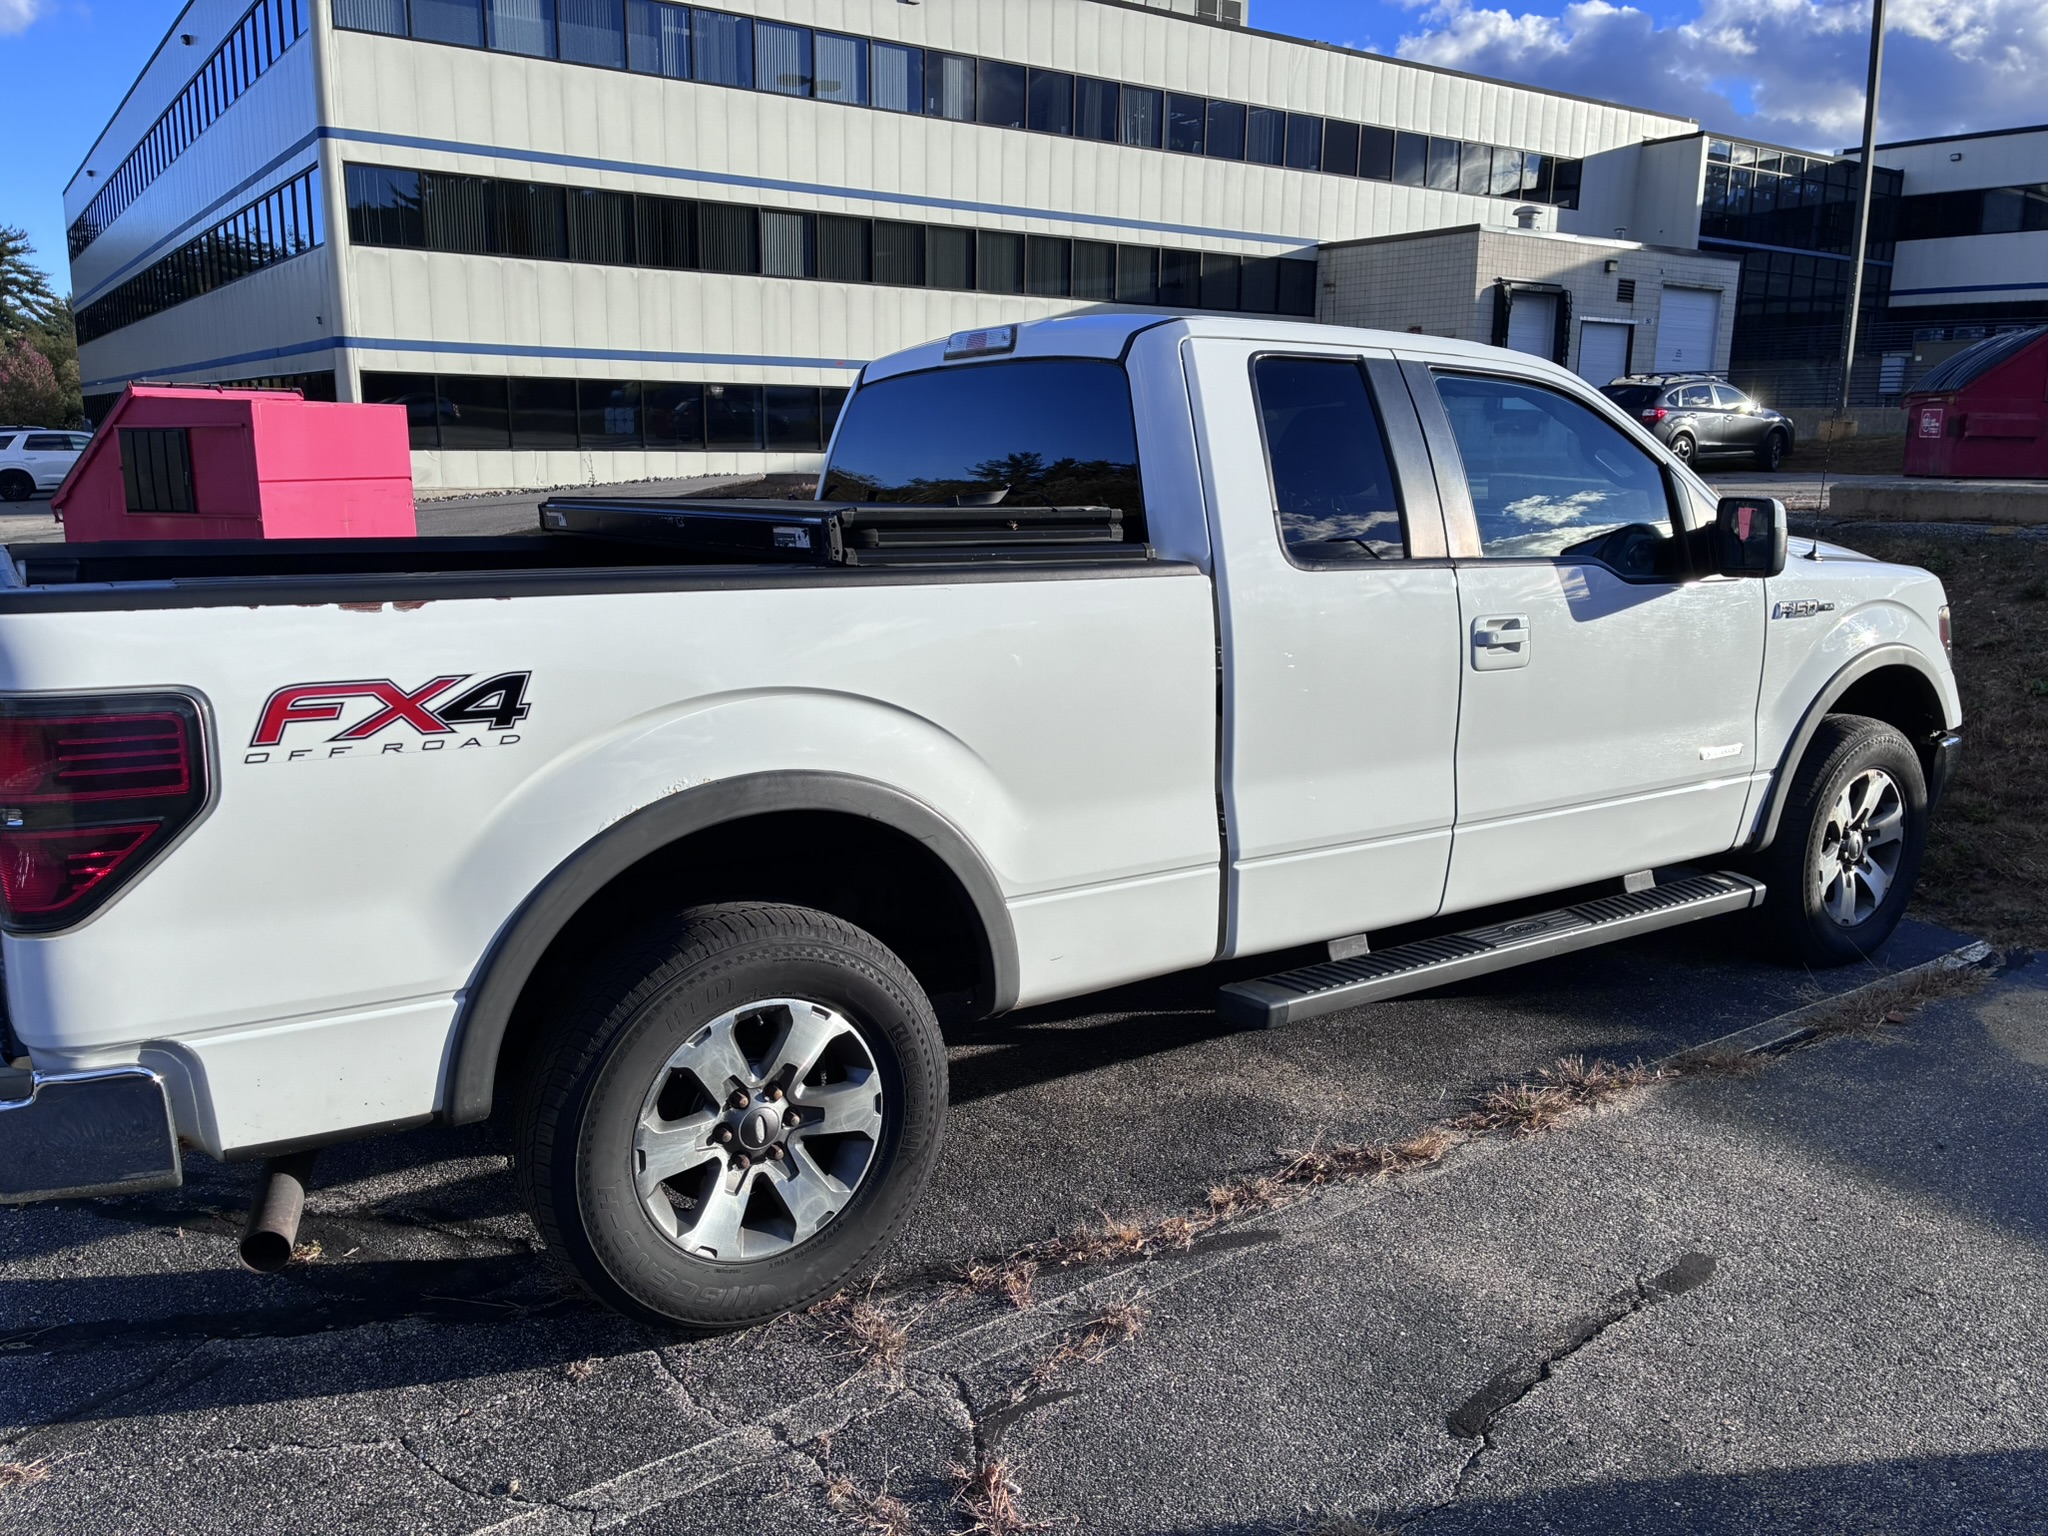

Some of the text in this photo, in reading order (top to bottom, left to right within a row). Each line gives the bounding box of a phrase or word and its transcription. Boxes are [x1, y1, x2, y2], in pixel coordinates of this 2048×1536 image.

[244, 734, 522, 765] OFF ROAD
[248, 670, 533, 748] FX4
[887, 1020, 925, 1166] BLACKHAWK
[597, 1186, 761, 1308] HISCEND-H
